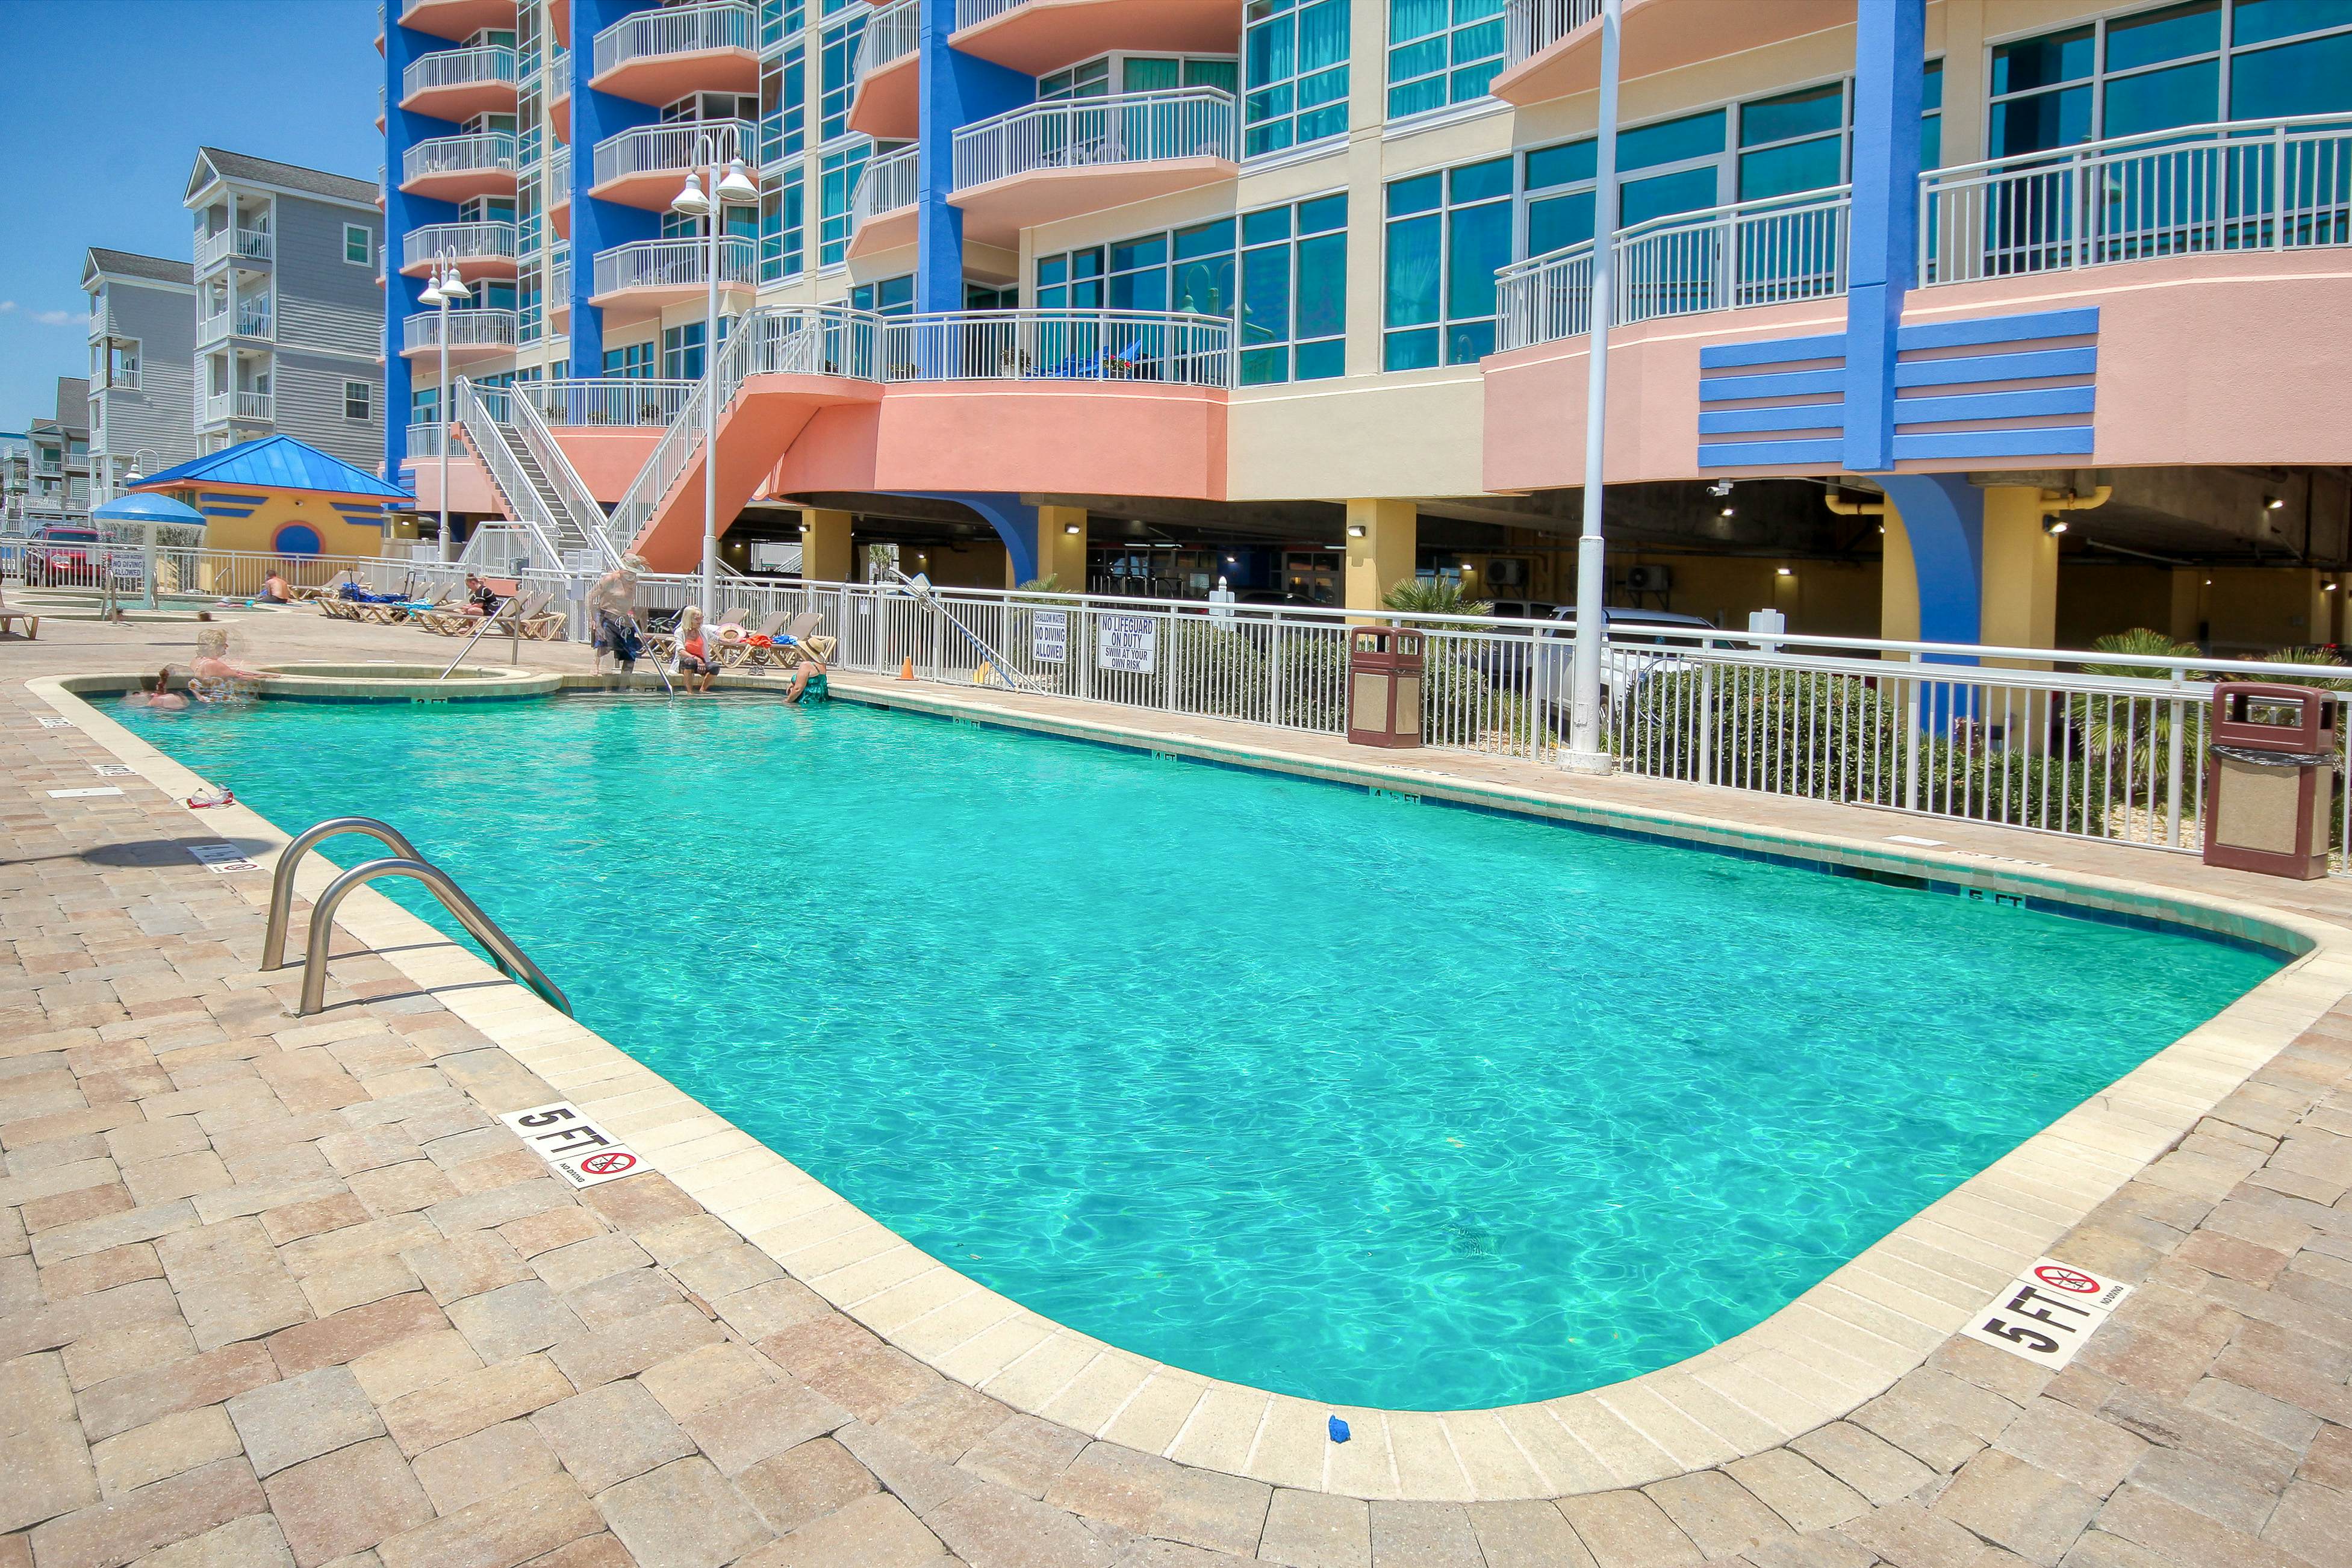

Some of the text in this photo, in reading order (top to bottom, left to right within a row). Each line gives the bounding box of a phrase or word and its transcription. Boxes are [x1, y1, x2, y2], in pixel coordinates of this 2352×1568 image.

[1034, 613, 1065, 624] SHALLOW WATER
[1102, 616, 1153, 635] NO LIFEGUARD
[1034, 626, 1065, 642] NO DIVING
[1112, 632, 1142, 649] ON DUTY
[1036, 643, 1063, 659] ALLOWED
[1106, 647, 1148, 661] SWIM AT YOUR
[1112, 658, 1140, 670] OWN RISK
[1404, 794, 1419, 804] FT
[1969, 889, 1985, 900] 5
[518, 1108, 611, 1154] 5 FT
[566, 1169, 585, 1183] DIVING
[2106, 1286, 2124, 1299] DIVING
[1982, 1285, 2091, 1354] 5 FT
